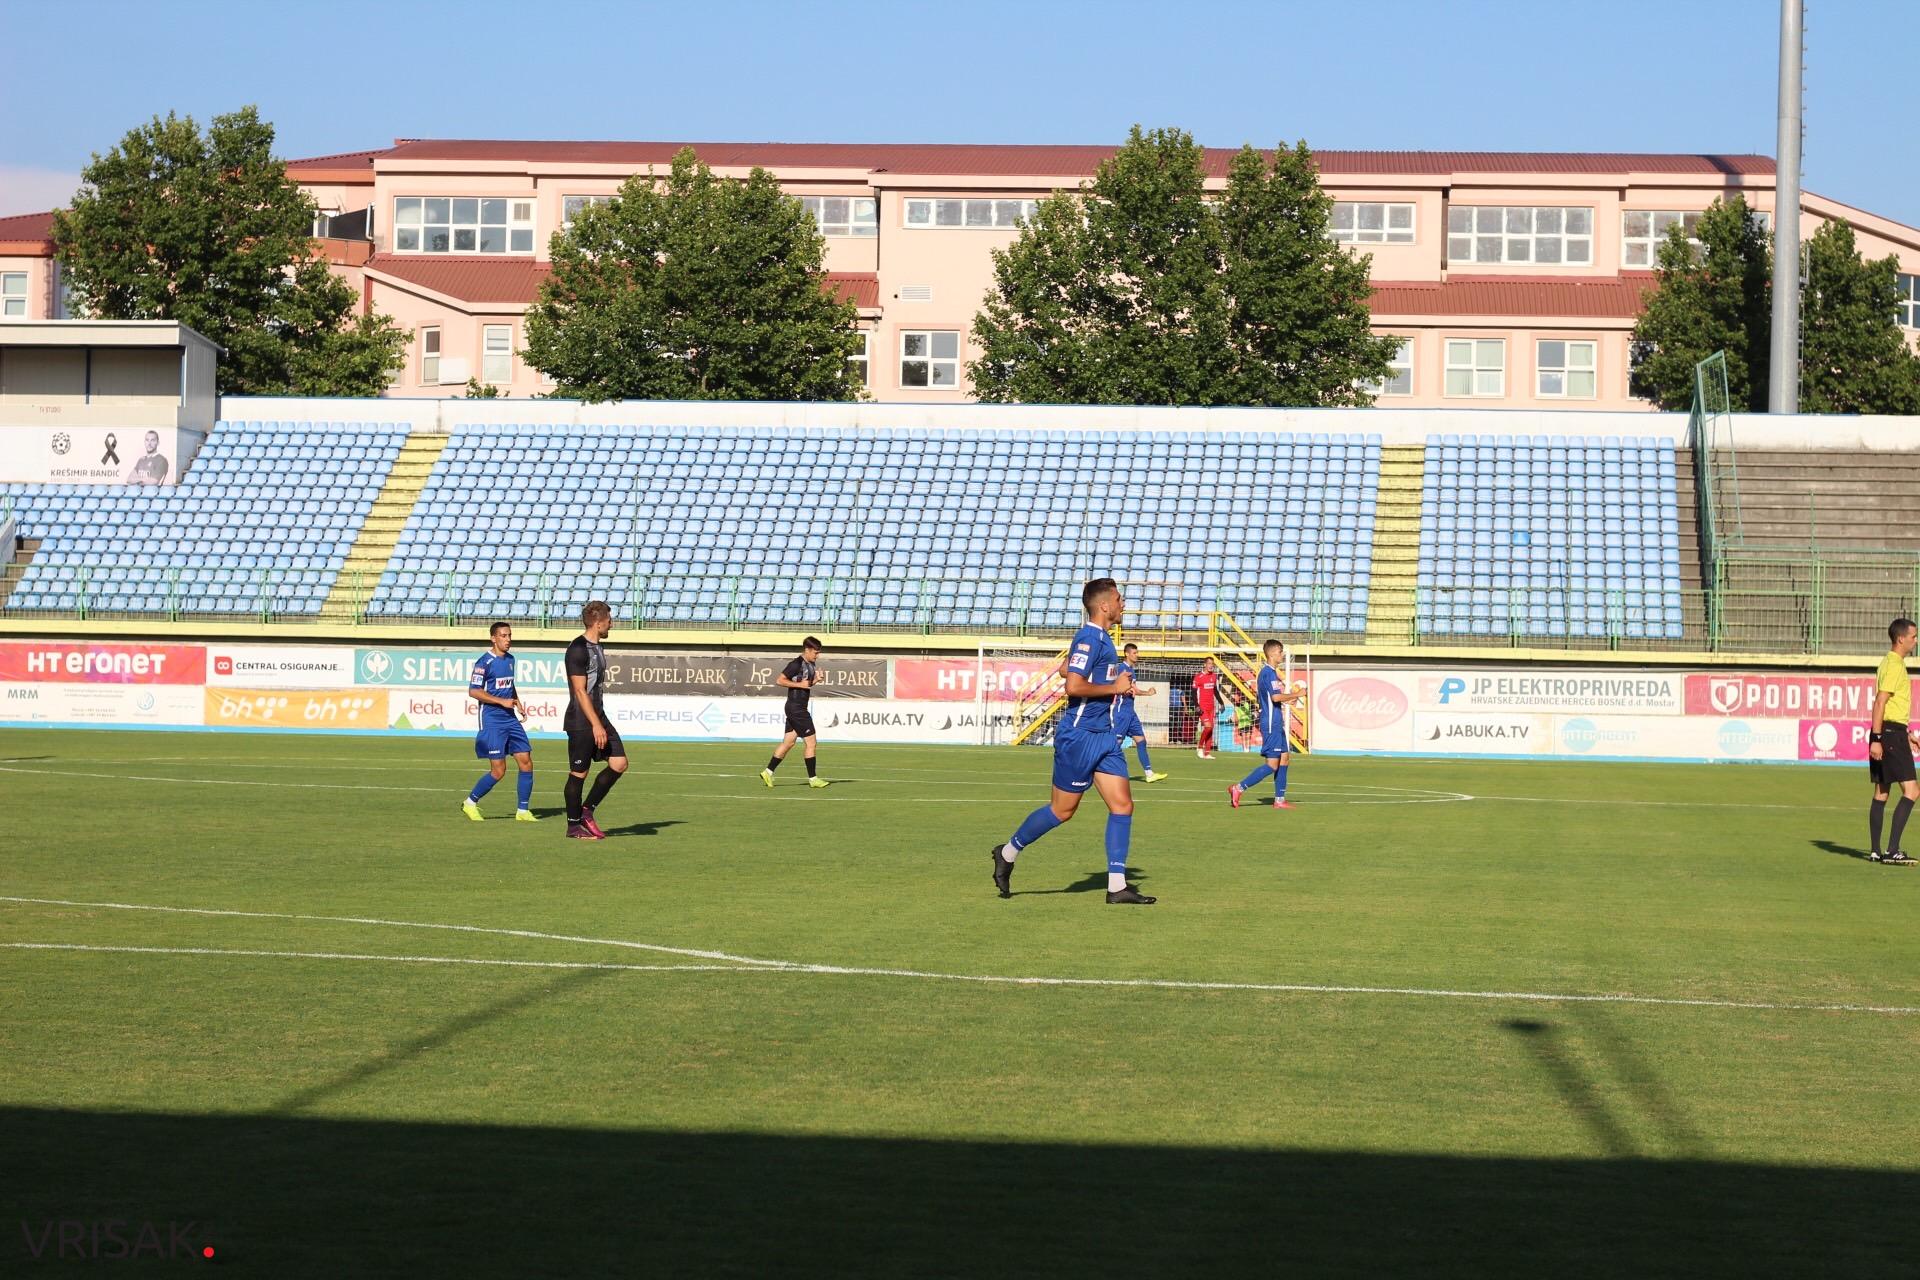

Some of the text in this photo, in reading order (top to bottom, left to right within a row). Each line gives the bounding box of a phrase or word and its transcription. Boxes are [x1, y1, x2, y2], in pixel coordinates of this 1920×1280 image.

[27, 652, 62, 672] HT
[236, 662, 277, 671] CENTRAL
[280, 662, 338, 671] OSIGURANJE
[631, 667, 726, 684] HOTEL PARK
[837, 670, 879, 686] PARK
[937, 669, 975, 690] HT
[8, 689, 39, 699] MRM
[1472, 678, 1672, 697] JP ELEKTROPRIVREDA
[409, 699, 443, 715] leda
[464, 700, 479, 715] le
[1327, 689, 1398, 715] Violeta
[1471, 696, 1514, 705] HRVATSKE
[1515, 696, 1560, 705] ZAJEDNICE
[1561, 697, 1596, 706] HERCEG
[1597, 698, 1627, 706] BOSNE
[1646, 699, 1675, 707] Mostar
[617, 710, 693, 722] EMERUS
[844, 713, 924, 727] JABUKA.TV
[1446, 724, 1529, 738] JABUKA.TV
